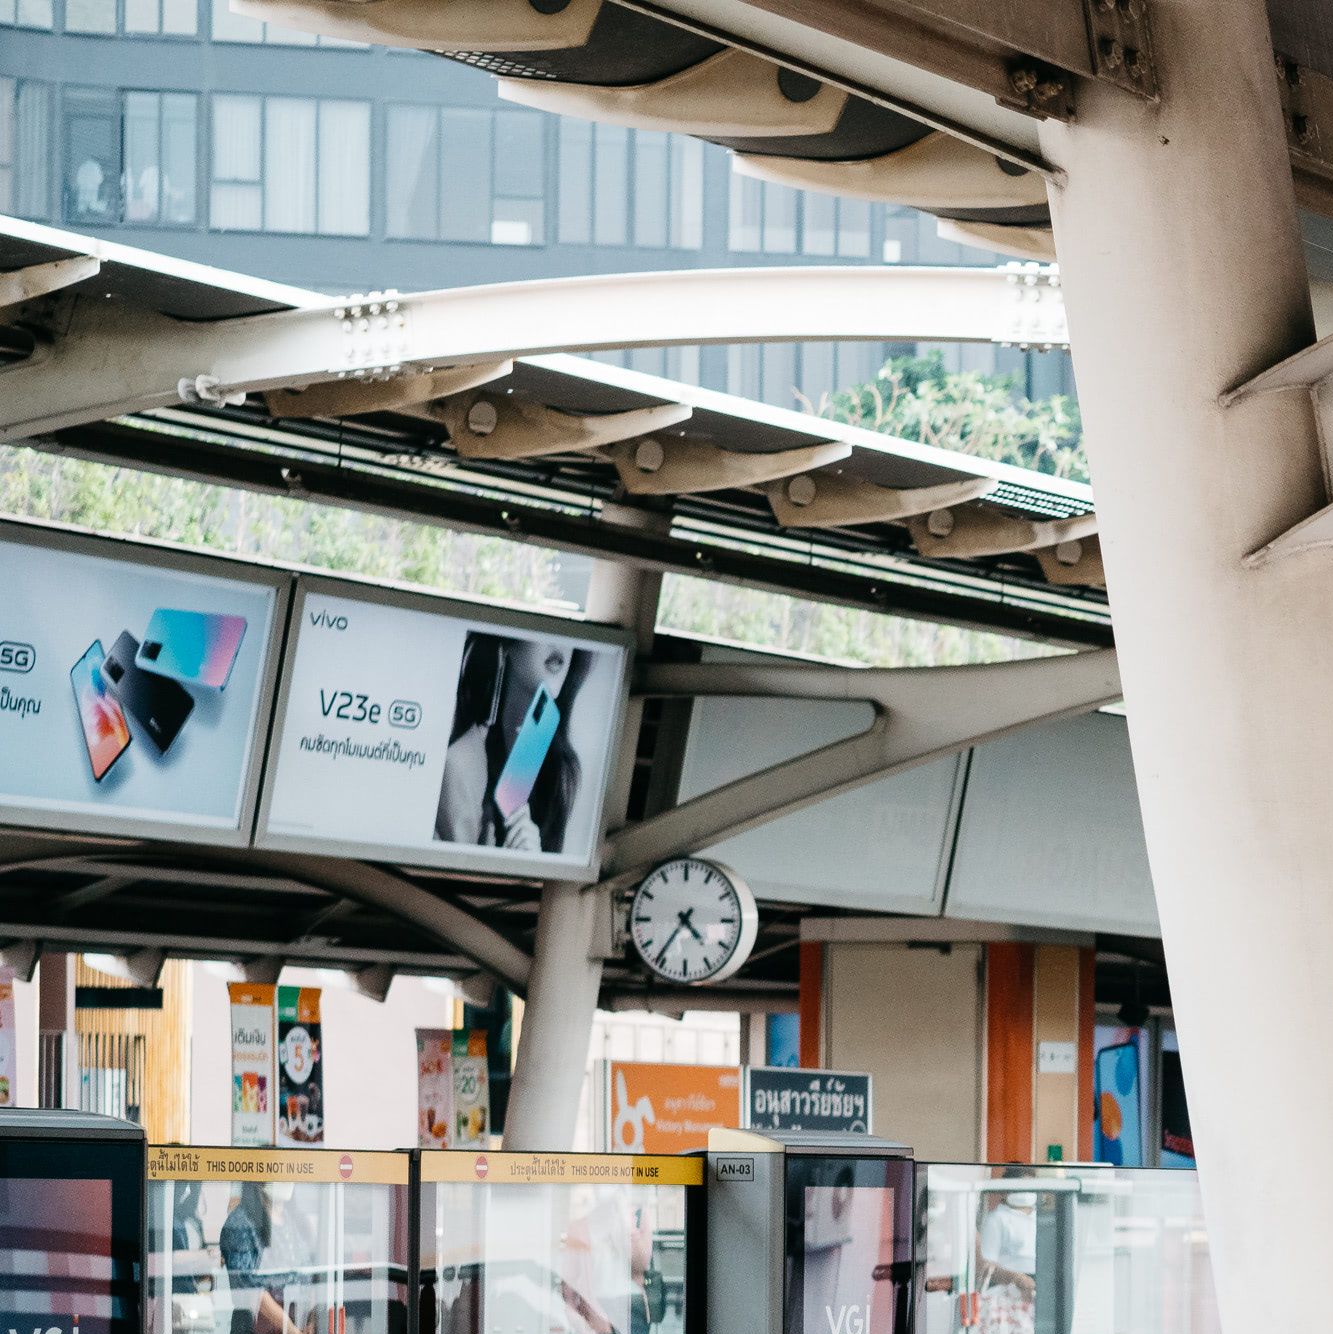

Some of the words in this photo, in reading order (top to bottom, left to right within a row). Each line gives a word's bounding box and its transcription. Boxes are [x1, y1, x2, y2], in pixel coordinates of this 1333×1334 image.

[309, 609, 349, 631] vivo
[1, 647, 29, 667] 5G
[320, 688, 381, 724] V23e
[392, 705, 417, 723] 5G
[754, 1077, 865, 1128] อนุสาวรีย์ชัยฯ
[206, 1160, 227, 1174] THIS
[228, 1160, 254, 1174] DOOR
[256, 1161, 264, 1174] IS
[266, 1161, 285, 1174] NOT
[285, 1162, 295, 1175] IN
[296, 1162, 314, 1175] USE
[571, 1164, 588, 1176] THIS
[589, 1165, 610, 1177] DOOR
[611, 1165, 619, 1177] IS
[620, 1165, 635, 1177] NOT
[636, 1166, 644, 1178] IN
[645, 1166, 659, 1178] USE
[720, 1162, 751, 1176] AN-03
